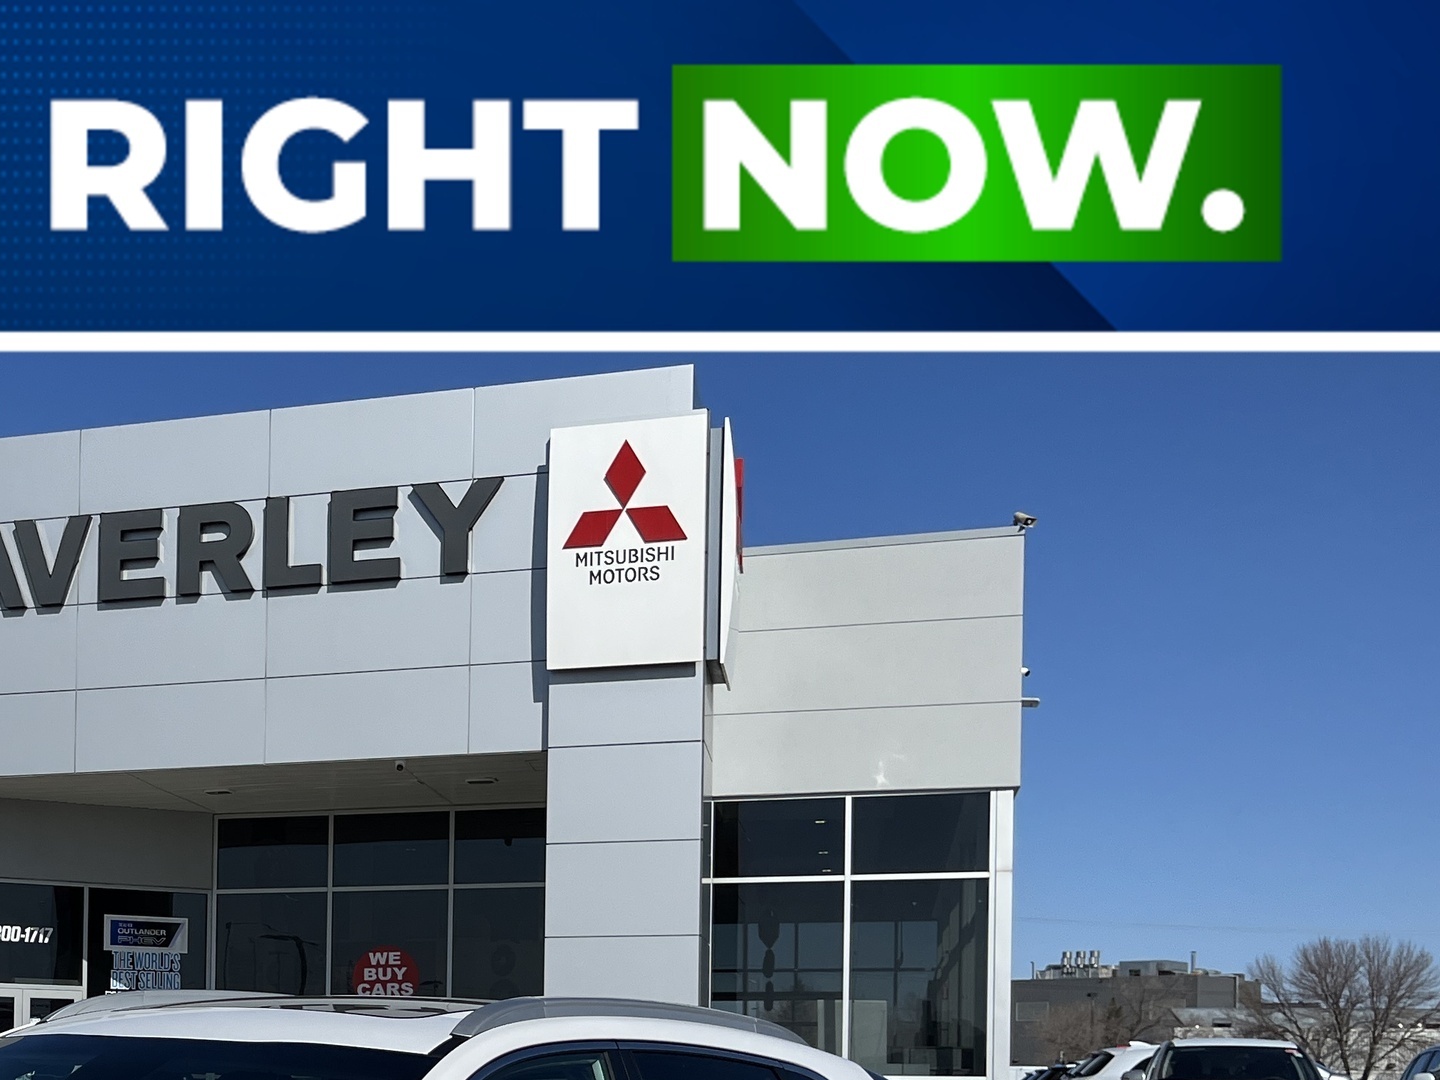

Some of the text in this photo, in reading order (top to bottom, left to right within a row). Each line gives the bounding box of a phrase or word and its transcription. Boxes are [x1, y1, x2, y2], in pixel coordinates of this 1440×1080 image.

[575, 545, 675, 568] MITSUBISHI
[589, 565, 660, 585] MOTORS
[117, 928, 166, 936] OUTLANDER
[117, 936, 166, 945] PHEV
[113, 951, 181, 971] THE WORLD'S
[368, 952, 401, 965] WE
[111, 970, 181, 990] BEST SELLING
[363, 967, 407, 980] BUY
[357, 982, 414, 996] CARS
